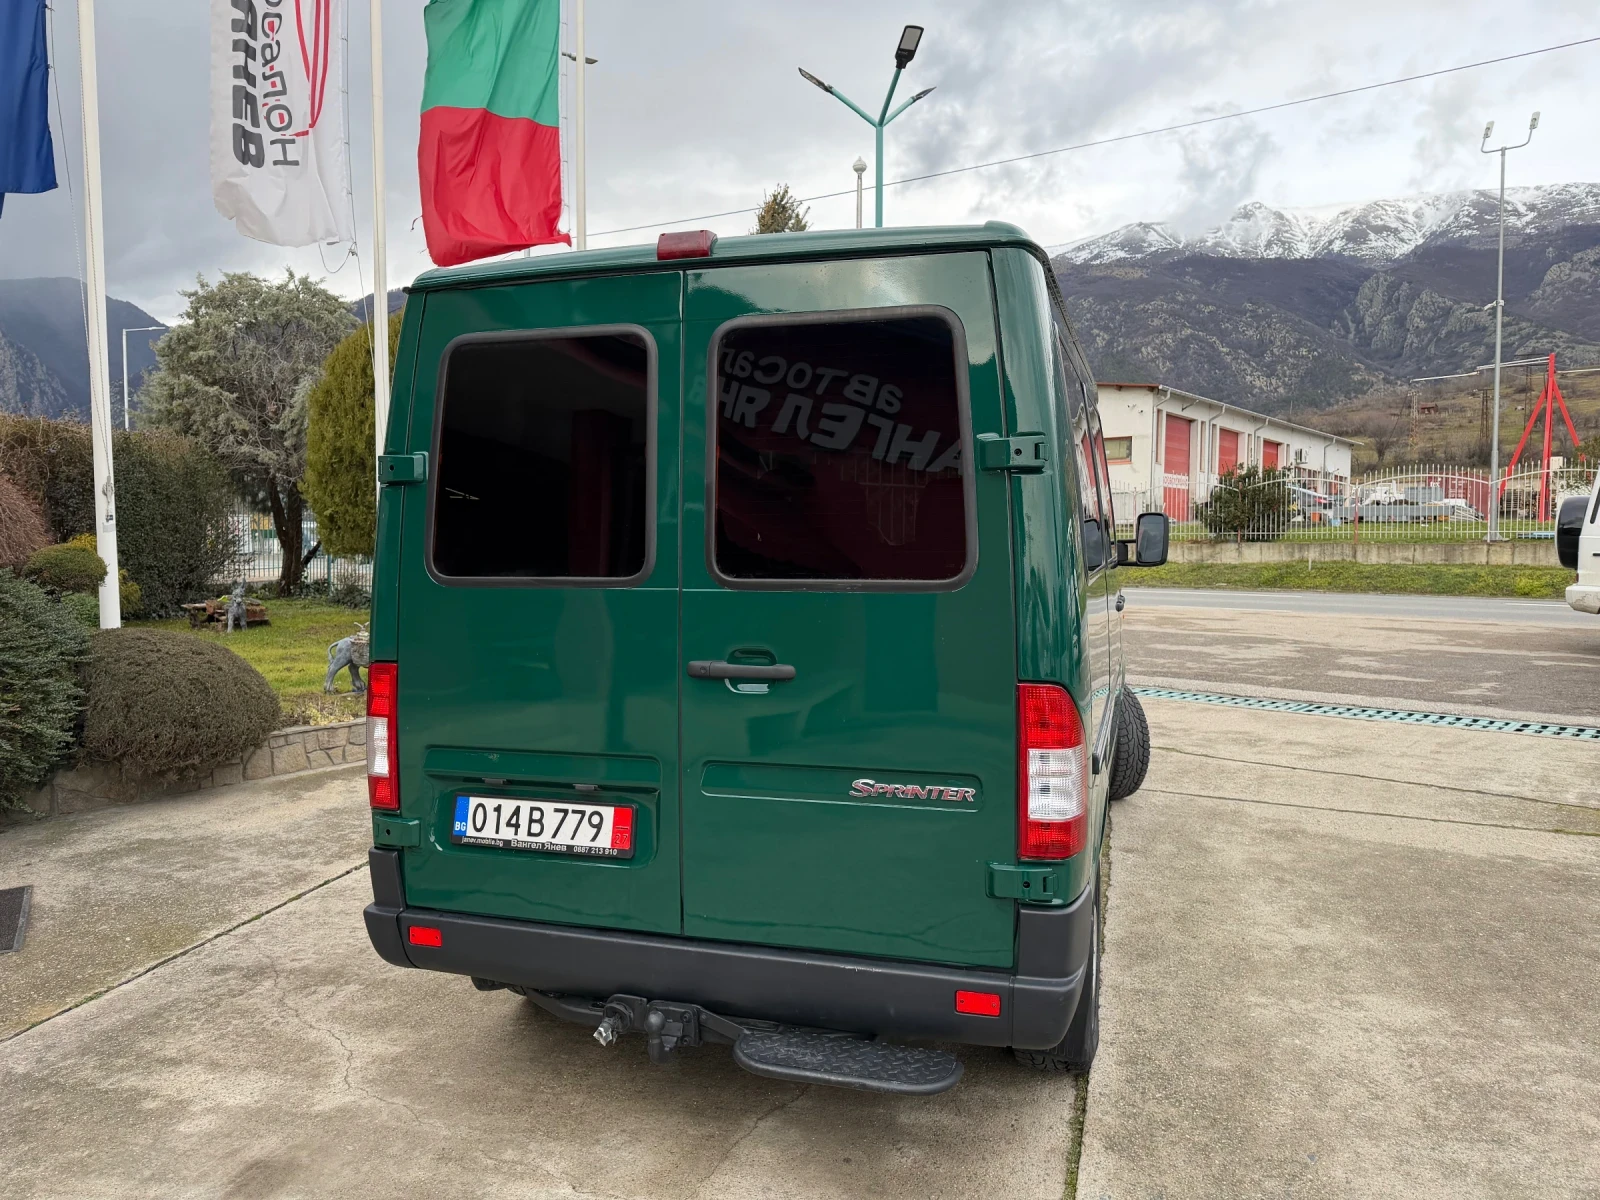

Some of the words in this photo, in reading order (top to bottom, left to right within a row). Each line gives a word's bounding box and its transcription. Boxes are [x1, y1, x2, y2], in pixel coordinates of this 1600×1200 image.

[230, 0, 266, 169] ЯНЕВ
[261, 0, 300, 167] салон
[849, 778, 976, 802] SPRINTER
[454, 821, 467, 831] BG
[511, 839, 542, 850] Вангел
[544, 842, 567, 851] Янев
[614, 833, 629, 845] 27
[591, 847, 604, 855] 213
[604, 848, 618, 856] 910
